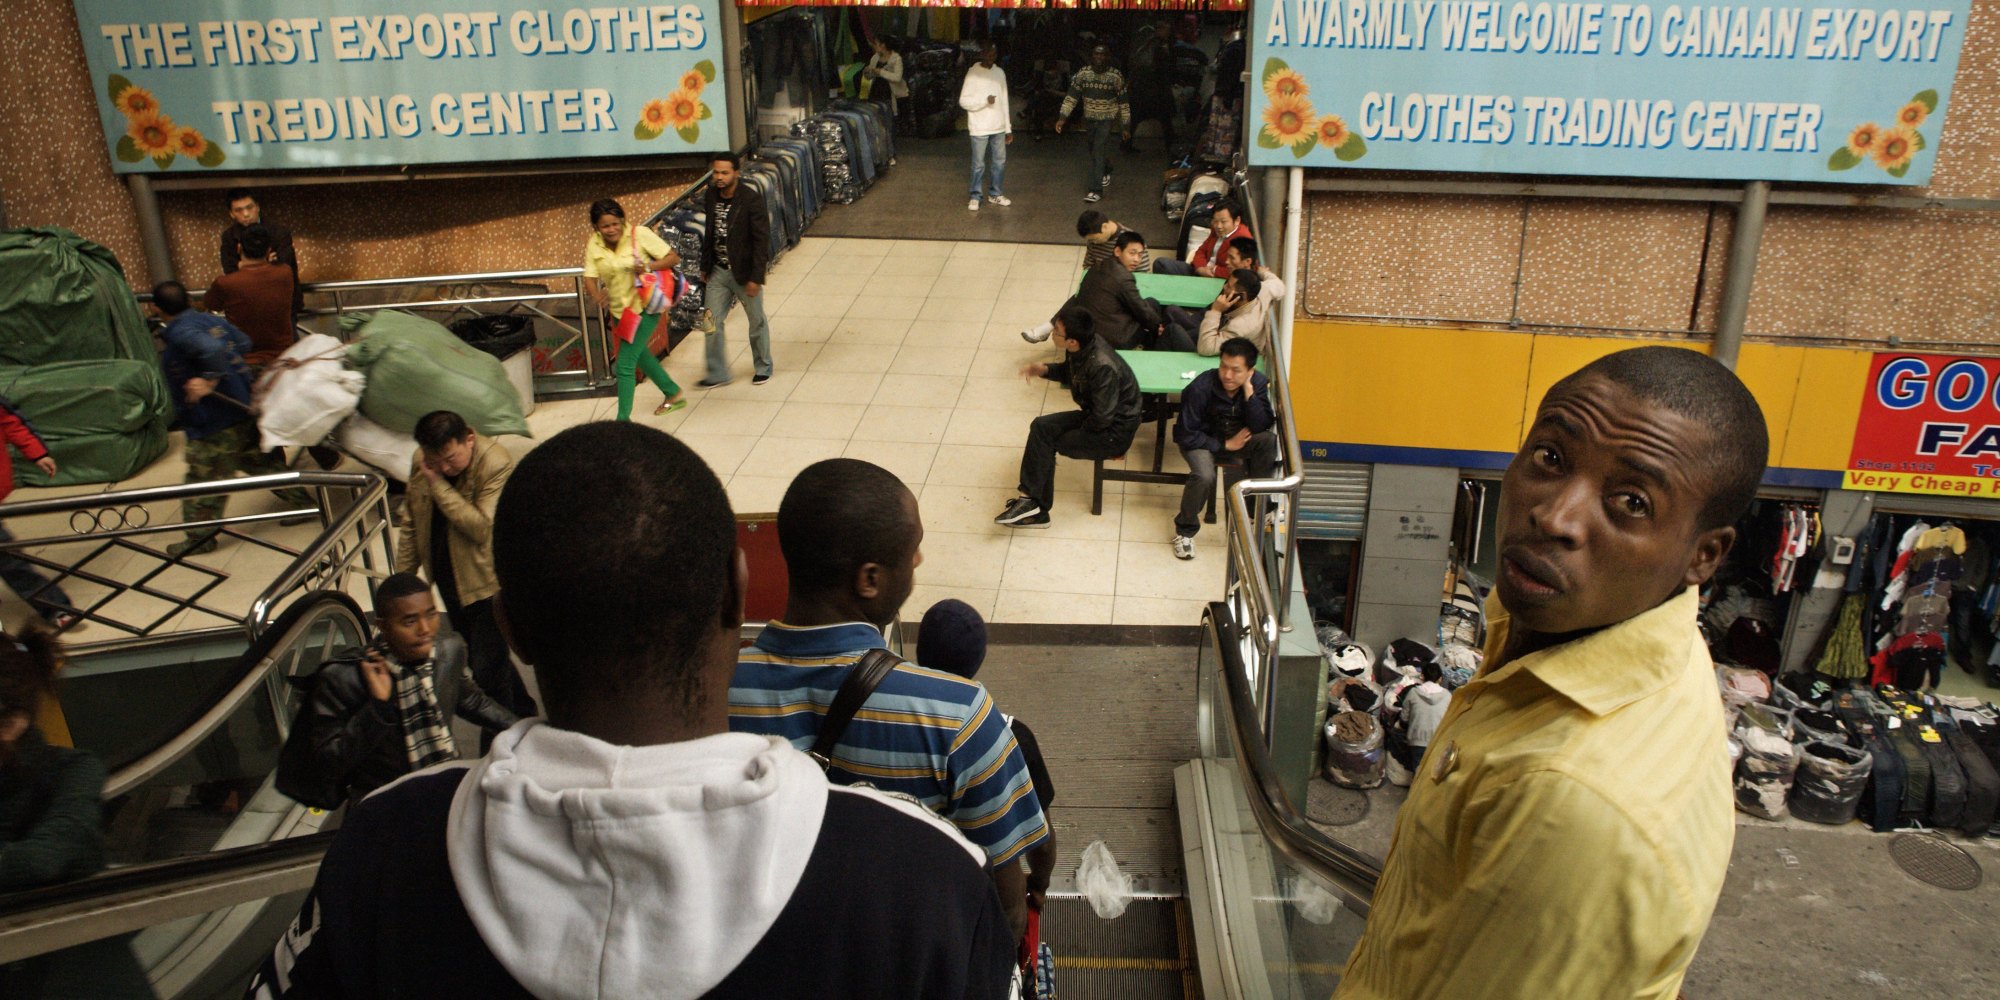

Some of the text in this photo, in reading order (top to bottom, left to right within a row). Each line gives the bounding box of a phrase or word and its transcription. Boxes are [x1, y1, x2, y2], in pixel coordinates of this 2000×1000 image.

[101, 4, 706, 69] THE FIRST EXPORT CLOTHES
[1265, 0, 1952, 62] A WARMLY WELCOME TO CANAAN EXPORT
[212, 88, 618, 144] TREDING CENTER
[1359, 91, 1823, 152] CLOTHES TRADING CENTER
[1877, 358, 2000, 413] GO
[1850, 471, 1900, 490] Very
[1910, 475, 1982, 495] Cheap
